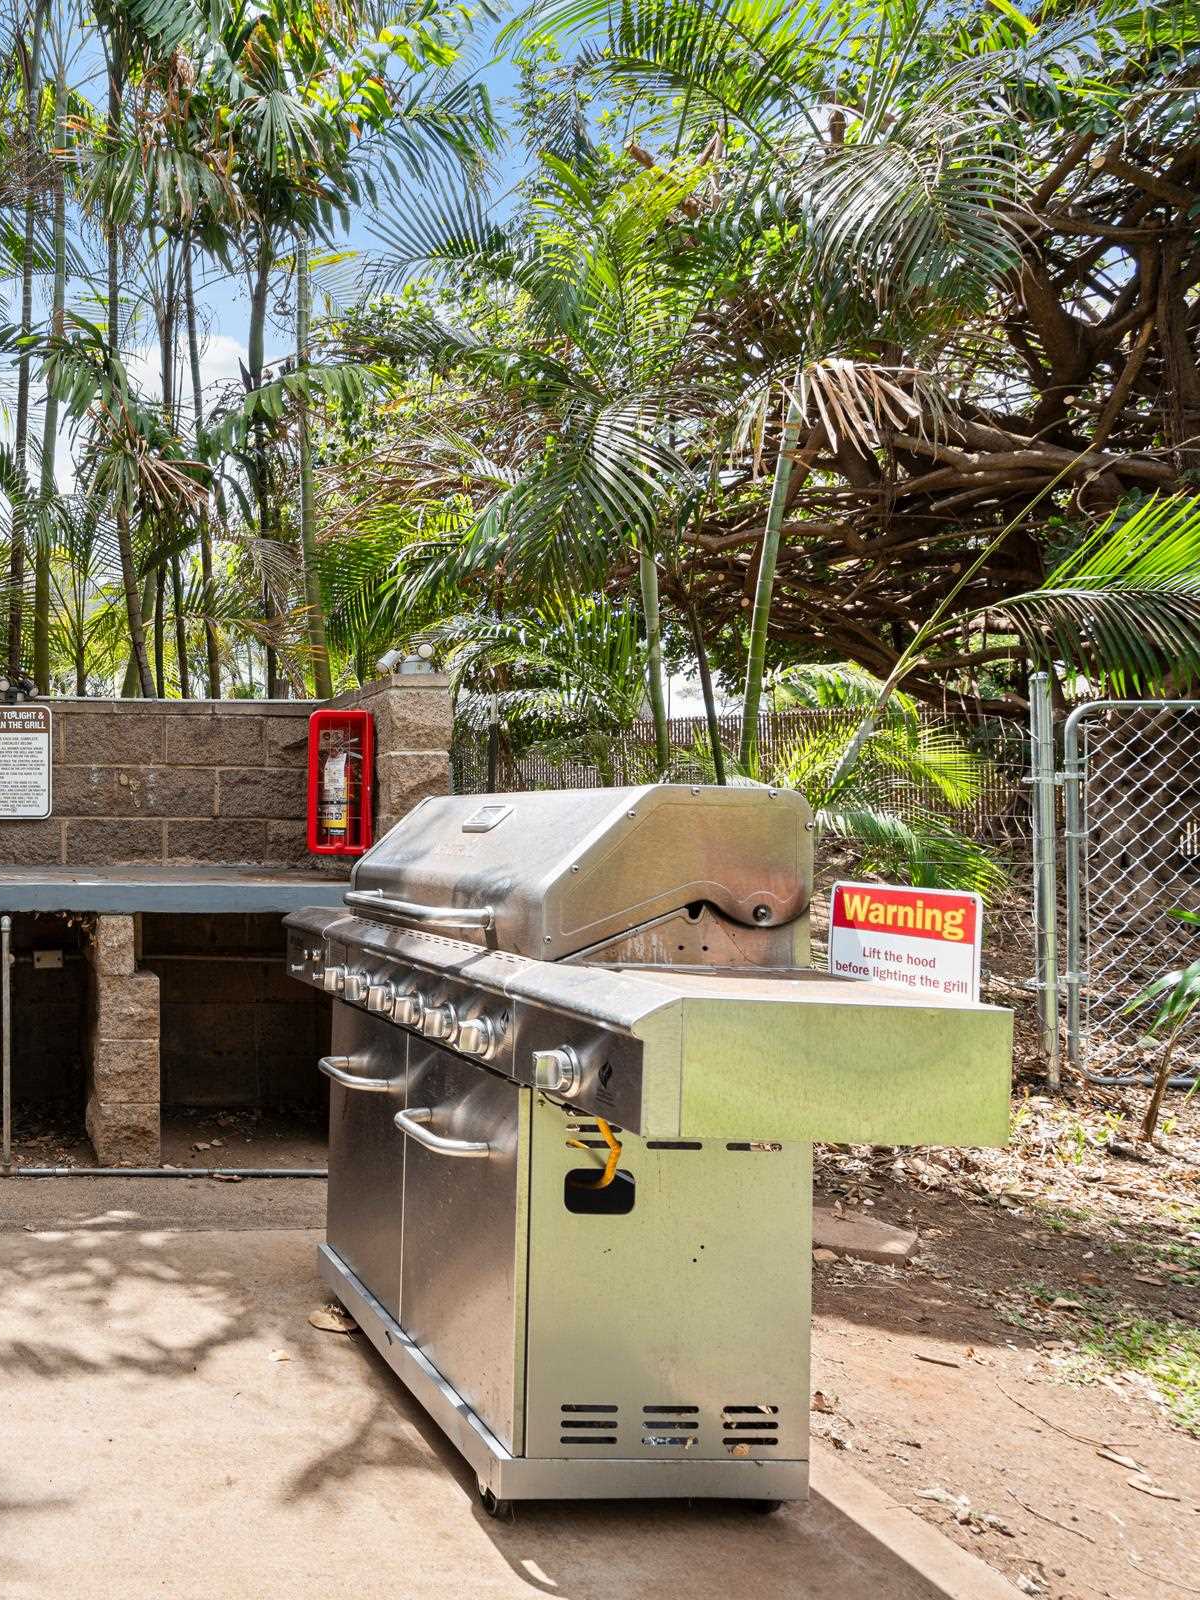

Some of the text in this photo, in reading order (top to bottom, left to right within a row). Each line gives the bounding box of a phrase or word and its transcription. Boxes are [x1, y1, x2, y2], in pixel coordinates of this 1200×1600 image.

[2, 711, 13, 720] TO
[14, 711, 36, 720] LIGHT
[37, 712, 45, 720] &
[8, 720, 23, 729] THE
[24, 720, 46, 729] GRILL
[842, 892, 966, 941] Warning
[862, 946, 936, 969] Lift the hood
[835, 960, 968, 994] before lighting the grill
